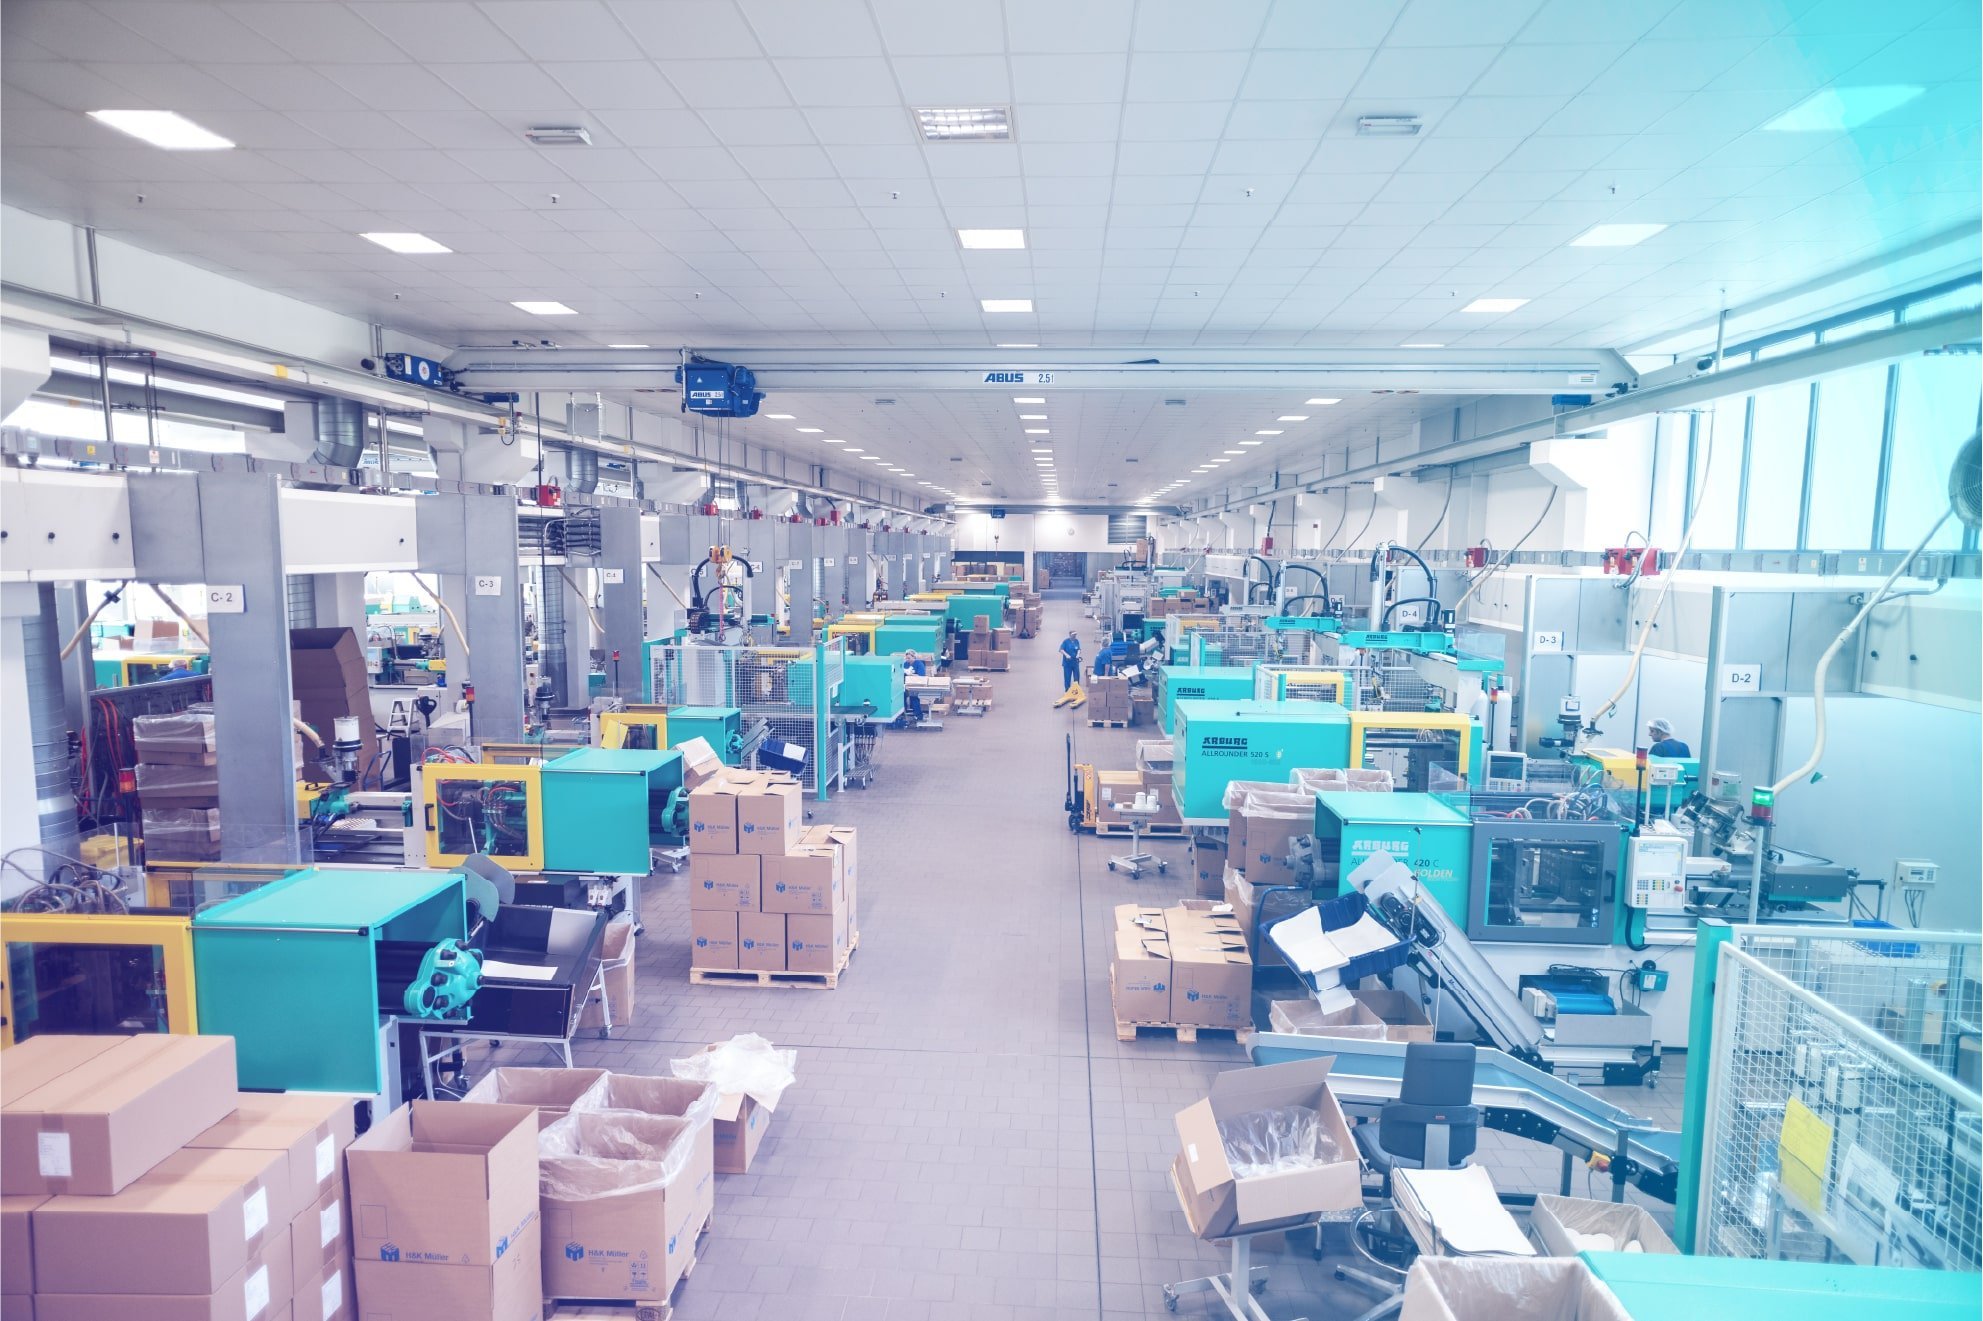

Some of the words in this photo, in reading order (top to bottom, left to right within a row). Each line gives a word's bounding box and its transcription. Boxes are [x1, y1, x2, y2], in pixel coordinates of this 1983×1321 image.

[984, 373, 1024, 383] ABUS
[479, 580, 494, 588] C-3
[210, 592, 233, 603] C-2
[1402, 610, 1417, 618] D-4
[1539, 635, 1557, 644] D-3
[1731, 673, 1752, 683] D-2
[1203, 737, 1248, 745] ARBURG
[1201, 750, 1248, 758] ALLROUNDER
[1352, 840, 1409, 851] ARBURG
[1432, 860, 1440, 868] C
[405, 1251, 422, 1260] H&K
[424, 1251, 449, 1261] Müller
[588, 1249, 604, 1257] H&K
[606, 1249, 630, 1258] Müller
